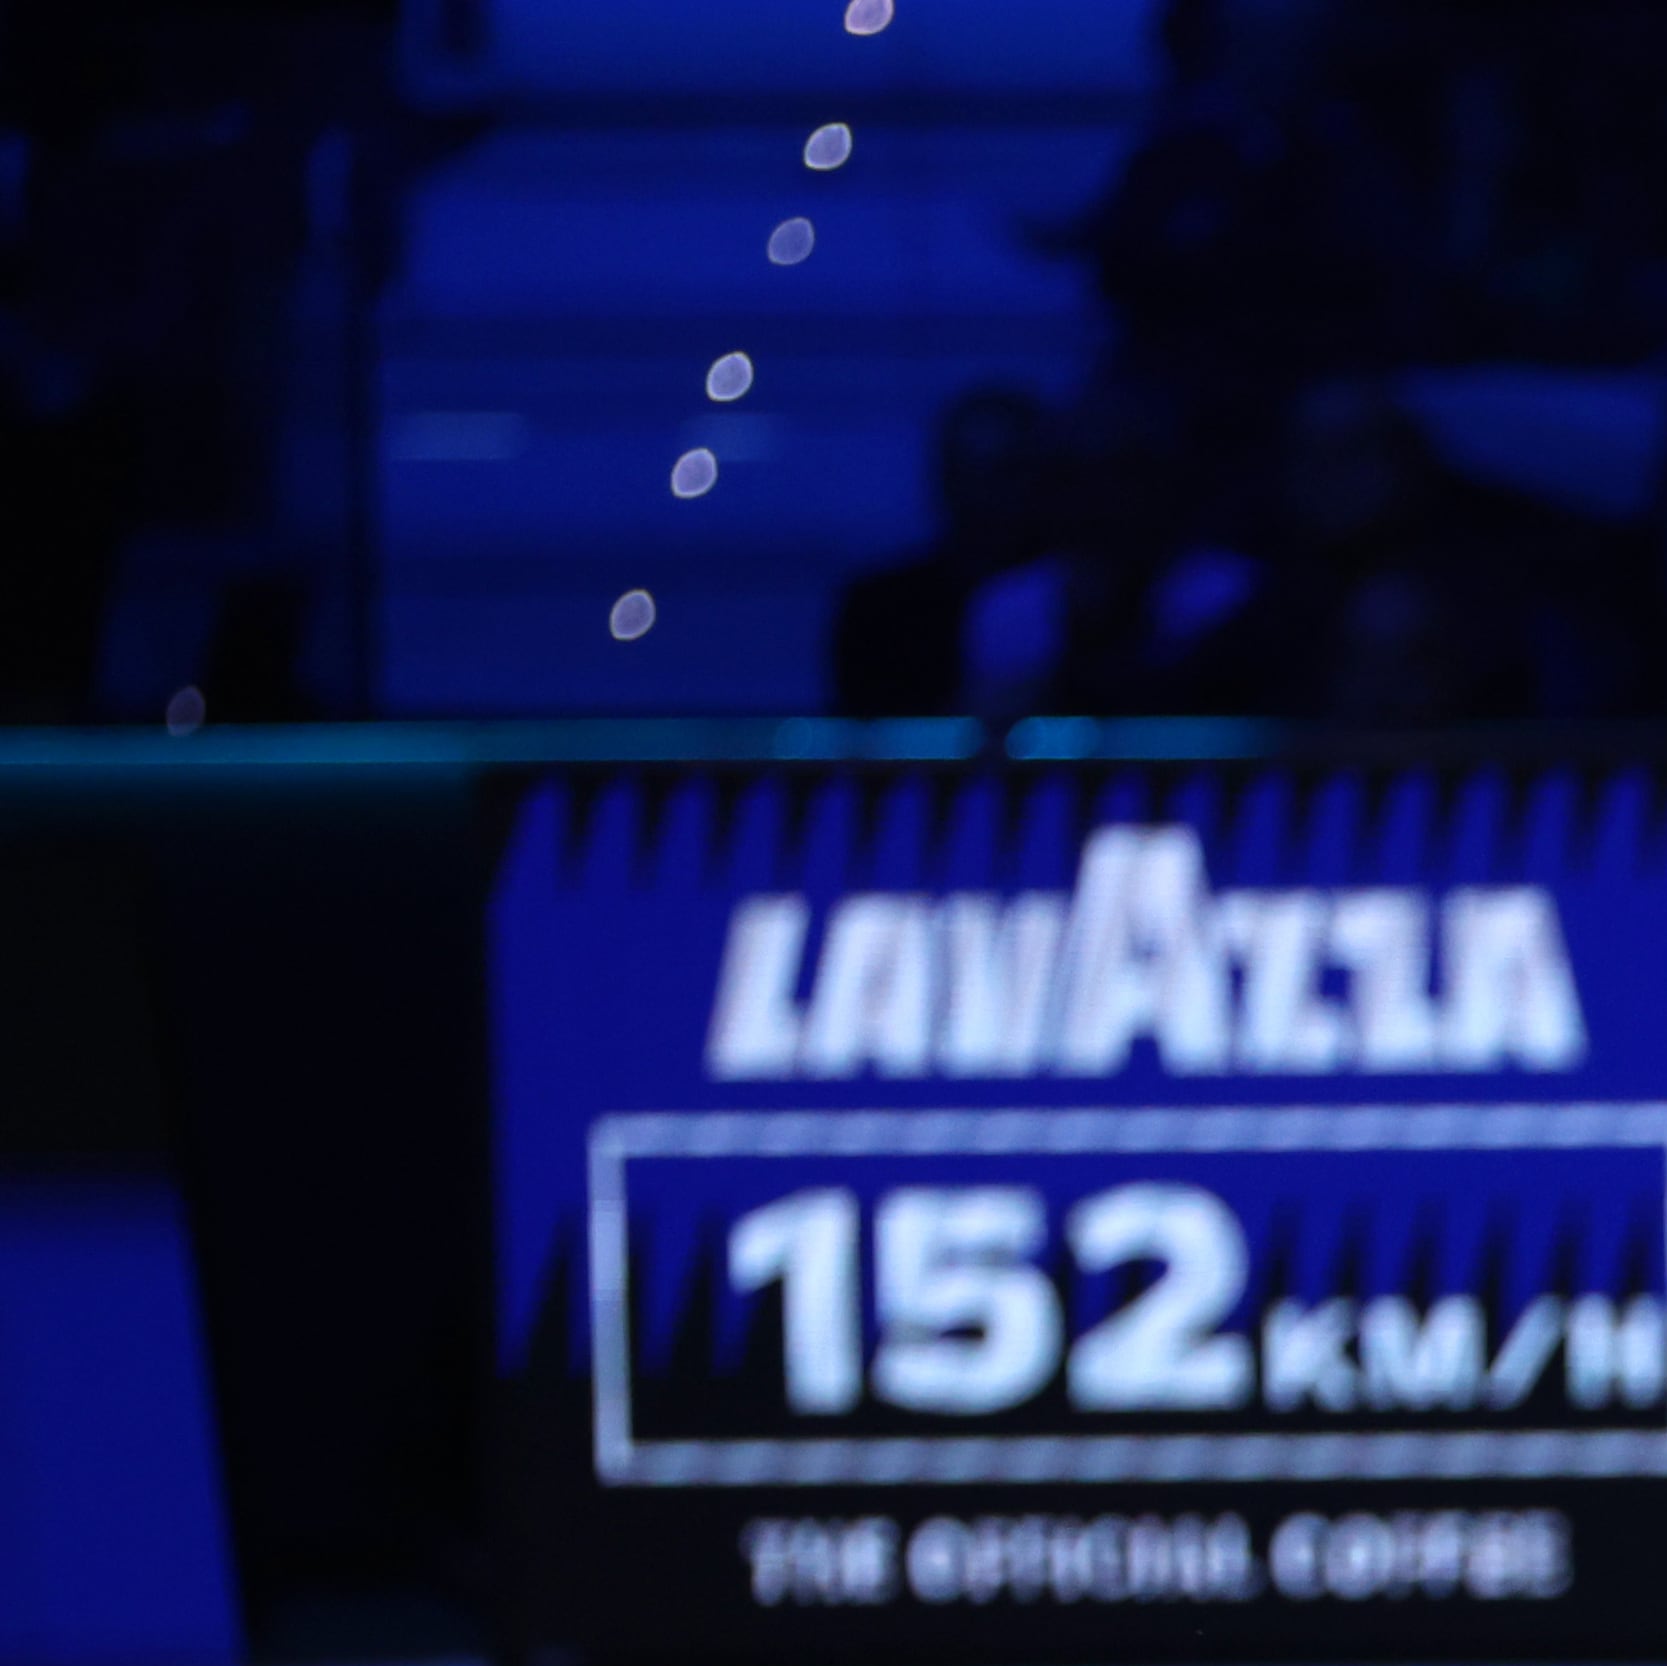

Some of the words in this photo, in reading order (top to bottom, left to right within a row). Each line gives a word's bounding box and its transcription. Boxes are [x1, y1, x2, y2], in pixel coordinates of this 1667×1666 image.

[706, 822, 1588, 1082] LAVAZZA
[728, 1183, 1255, 1415] 152
[1261, 1295, 1667, 1410] KM/H
[906, 1511, 1262, 1606] OFFICIAL
[1270, 1508, 1573, 1602] COFFEE
